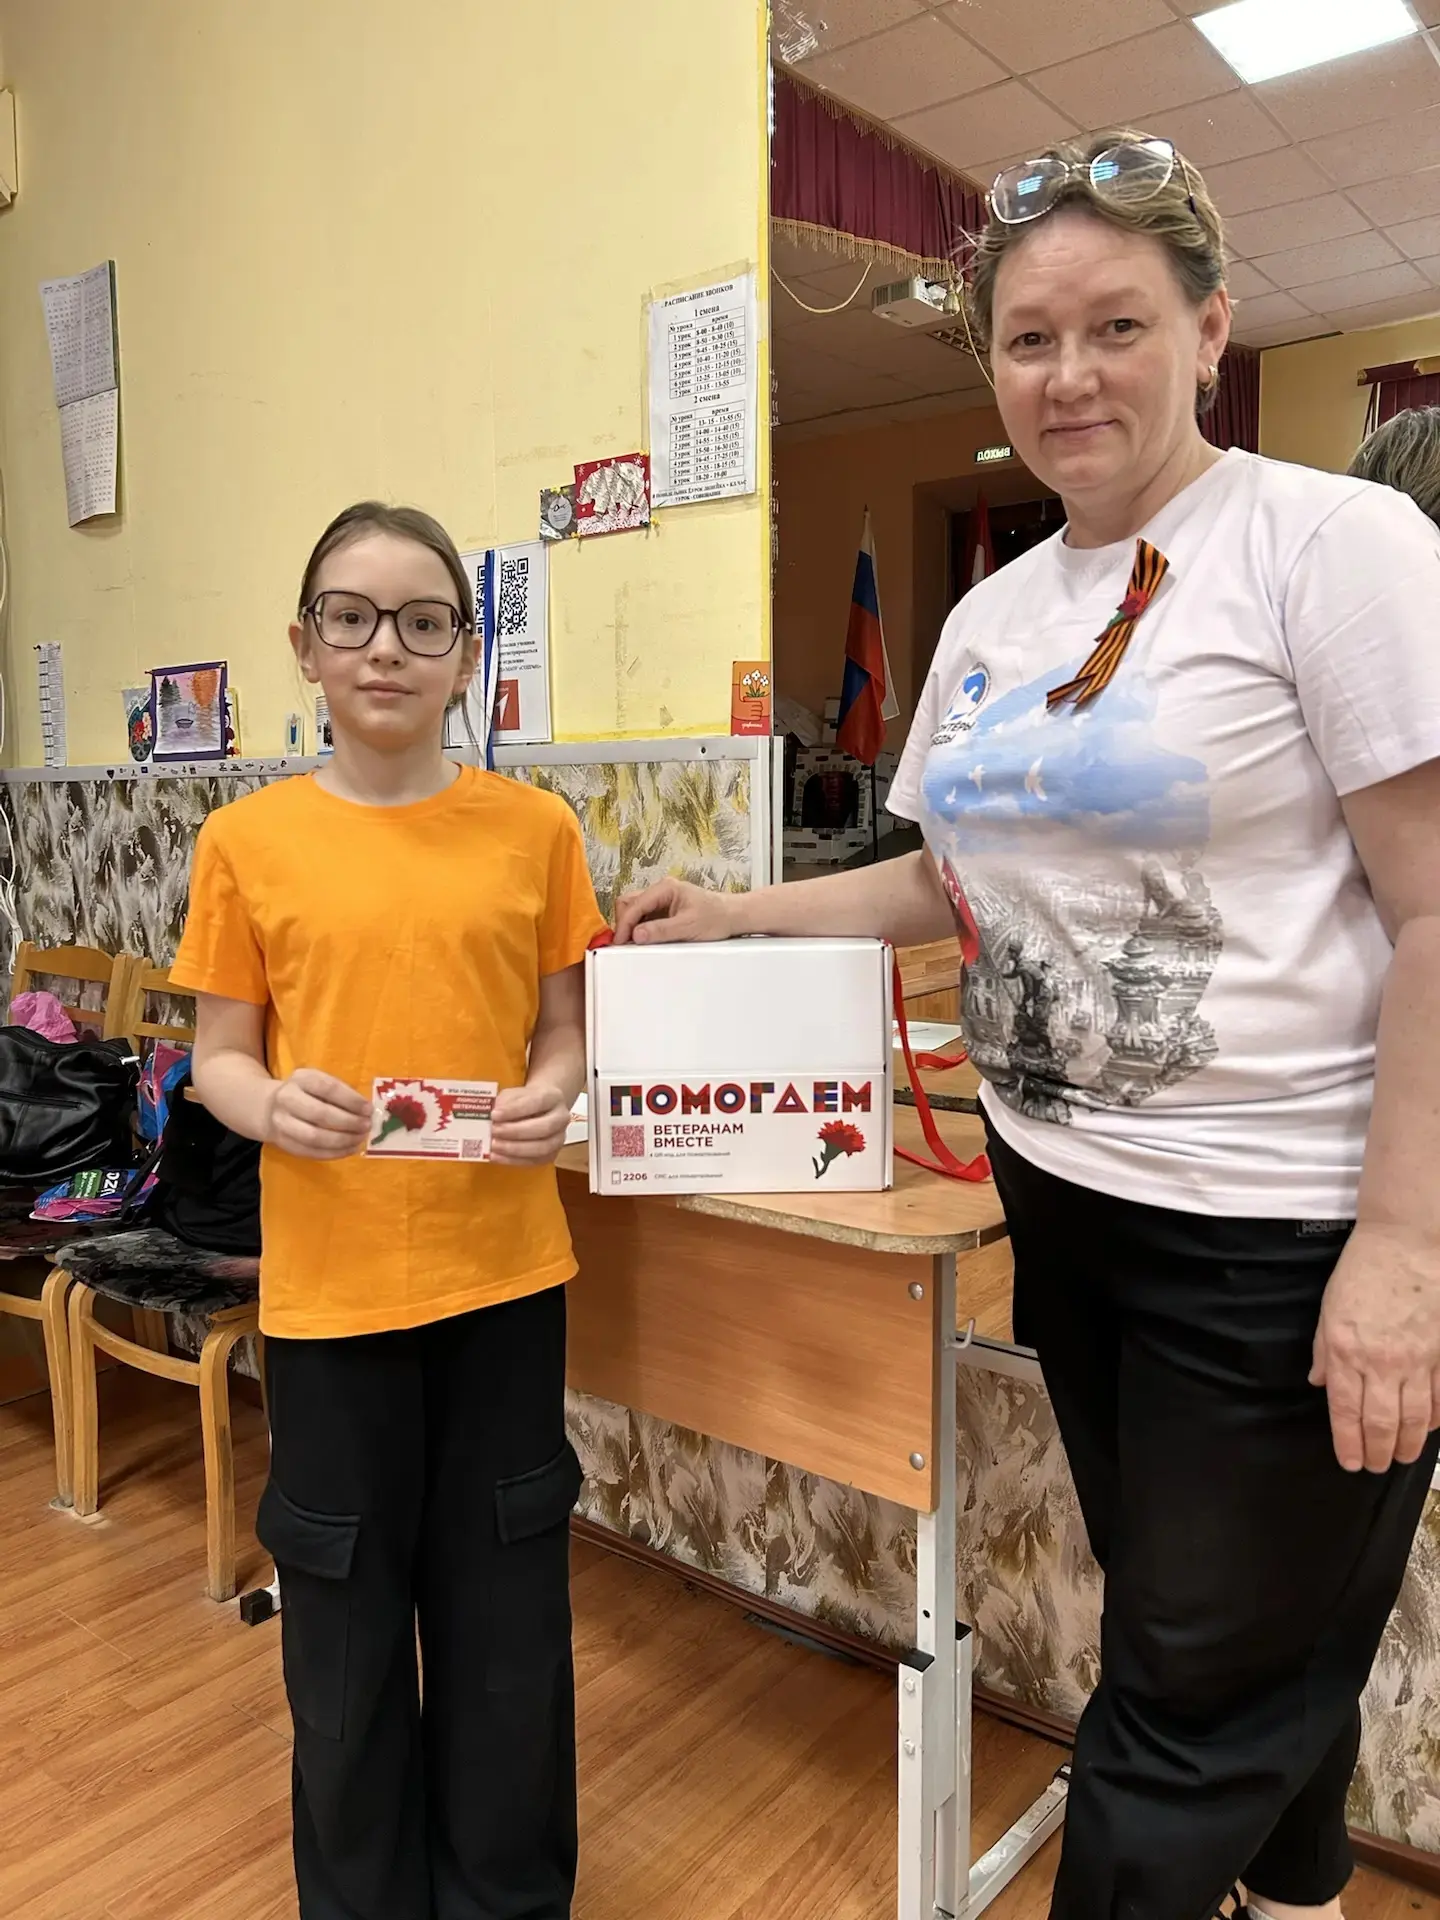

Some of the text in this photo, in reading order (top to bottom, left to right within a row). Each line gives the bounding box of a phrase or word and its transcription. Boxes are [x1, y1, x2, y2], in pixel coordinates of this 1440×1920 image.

[665, 285, 733, 307] РАСПИСАНИЕ ЗВОНКОВ
[695, 305, 719, 317] 1 смена
[677, 323, 693, 333] урока
[712, 314, 728, 324] время
[678, 333, 691, 342] урок
[678, 343, 691, 351] урок
[679, 352, 691, 361] урок
[679, 361, 691, 370] урок
[679, 370, 691, 379] урок
[679, 379, 691, 388] урок
[679, 389, 691, 397] урок
[699, 394, 720, 402] смена
[678, 414, 693, 423] урока
[712, 407, 729, 416] время
[679, 424, 691, 432] урок
[679, 433, 691, 441] урок
[679, 442, 690, 450] урок
[678, 451, 690, 459] урок
[678, 460, 690, 468] урок
[678, 469, 690, 477] урок
[678, 478, 690, 487] урок
[610, 1081, 872, 1116] ПОМОГАЕМ
[654, 1123, 744, 1135] ВЕТЕРАНАМ
[654, 1136, 713, 1148] ВМЕСТЕ
[624, 1172, 648, 1181] 2206
